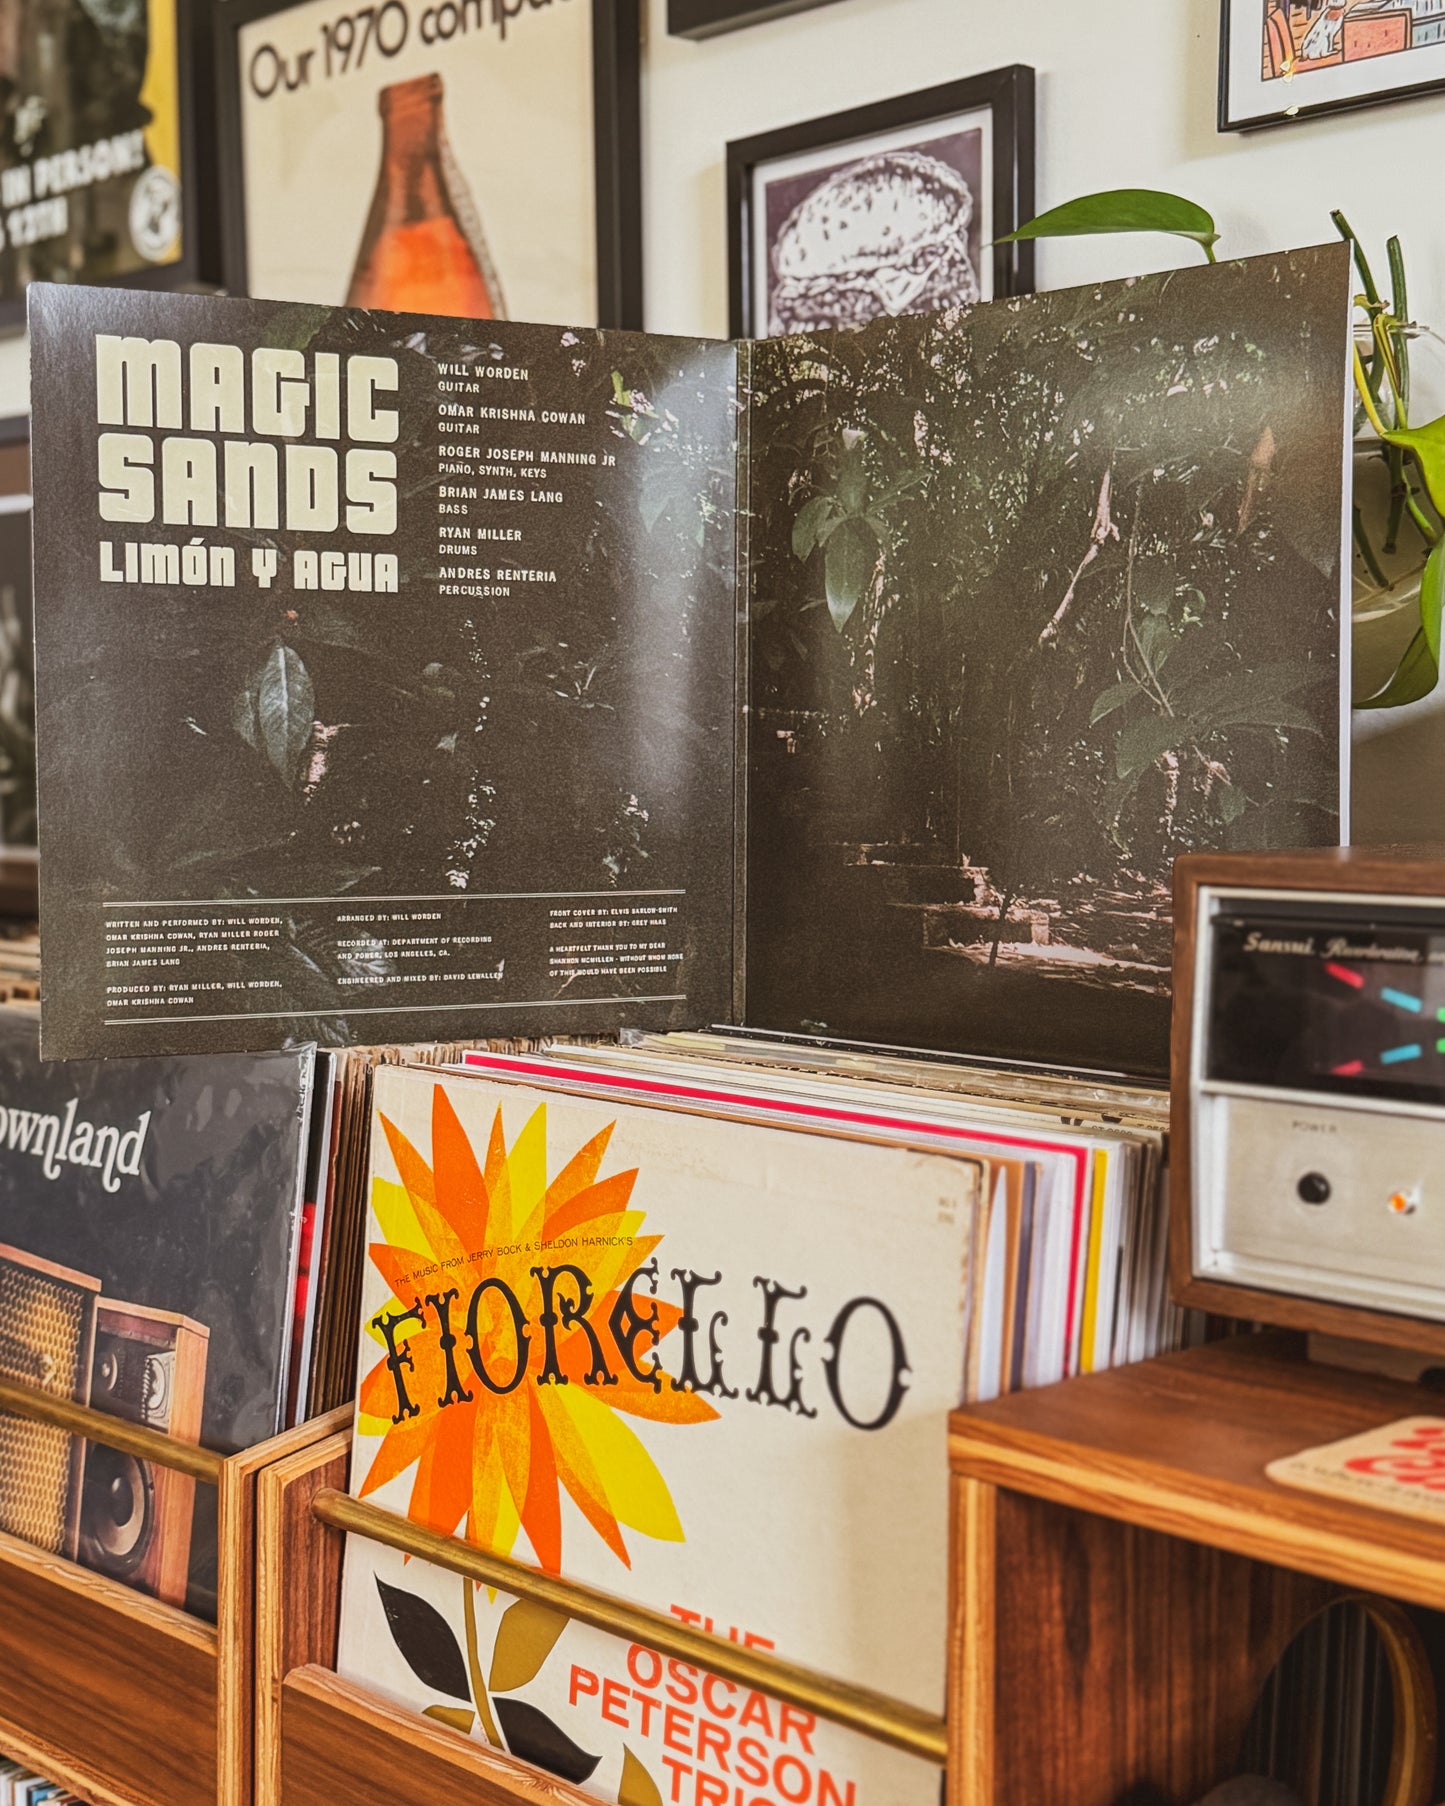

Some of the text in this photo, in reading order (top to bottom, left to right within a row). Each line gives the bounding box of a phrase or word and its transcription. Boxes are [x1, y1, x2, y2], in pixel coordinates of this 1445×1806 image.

[250, 43, 315, 99] Our
[321, 0, 409, 78] 1970
[438, 363, 529, 381] WILL WORDEN
[95, 333, 400, 443] MAGIC
[438, 380, 480, 394] GUITAR
[438, 404, 586, 425] OMAR KRISHNA COWAN
[438, 422, 480, 435] GUITAR
[438, 445, 616, 467] ROGER JOSEPH MANNING JR
[438, 463, 547, 479] PIANO, SYNTH, KEYS
[98, 432, 398, 536] SANDS
[438, 485, 564, 503] BRIAN JAMES LANG
[438, 503, 469, 515] BASS
[438, 527, 522, 541] RYAN MILLER
[438, 544, 478, 556] DRUMS
[99, 537, 399, 593] LIMÓN Y AGUA
[439, 567, 557, 583] ANDRES RENTERIA
[439, 585, 511, 597] PERCUSSION
[337, 914, 375, 922] ARRANGED
[392, 913, 410, 921] WILL
[411, 912, 442, 920] WORDEN
[549, 909, 571, 917] FRONT
[105, 920, 140, 928] WRITTEN
[162, 919, 209, 928] PERFORMED
[211, 918, 225, 926] BY:
[248, 917, 283, 925] WORDEN,
[549, 921, 568, 929] BACK
[585, 920, 617, 928] INTERIOR
[650, 918, 667, 926] HAAS
[167, 932, 196, 940] COWAN,
[198, 931, 219, 939] RYAN
[221, 930, 251, 938] MILLER
[337, 939, 376, 947] RECORDED
[392, 937, 439, 946] DEPARTMENT
[440, 936, 451, 944] OF
[451, 936, 493, 944] RECORDING
[105, 946, 137, 955] JOSEPH
[196, 944, 228, 952] ANDRES
[230, 943, 270, 951] RENTERIA,
[555, 944, 592, 952] HEARTFELT
[615, 943, 628, 951] YOU
[639, 942, 648, 950] MY
[337, 952, 353, 960] AND
[549, 957, 580, 965] SHANNON
[580, 956, 614, 964] MCMILLEN
[619, 954, 647, 962] WITHOUT
[647, 953, 666, 961] WHOM
[106, 958, 180, 968] BRIAN JAMES LANG
[576, 968, 600, 976] WOULD
[637, 965, 667, 973] POSSIBLE
[337, 972, 504, 985] ENGINEERED AND MIXED BY: DAVID LEWALLEN
[106, 985, 150, 994] PRODUCED
[153, 984, 167, 992] BY:
[168, 983, 189, 991] RYAN
[191, 982, 225, 991] MILLER,
[227, 981, 246, 989] WILL
[106, 999, 129, 1007] OMAR
[168, 996, 194, 1004] COWAN
[394, 1236, 634, 1288] THE MUSIC FROM JERRY BOCK & SHELDON HARNICK'S
[370, 1256, 913, 1431] FIORELLO
[625, 1642, 817, 1756] OSCAR
[568, 1663, 857, 1806] PETERSON
[660, 1754, 772, 1806] TRI
